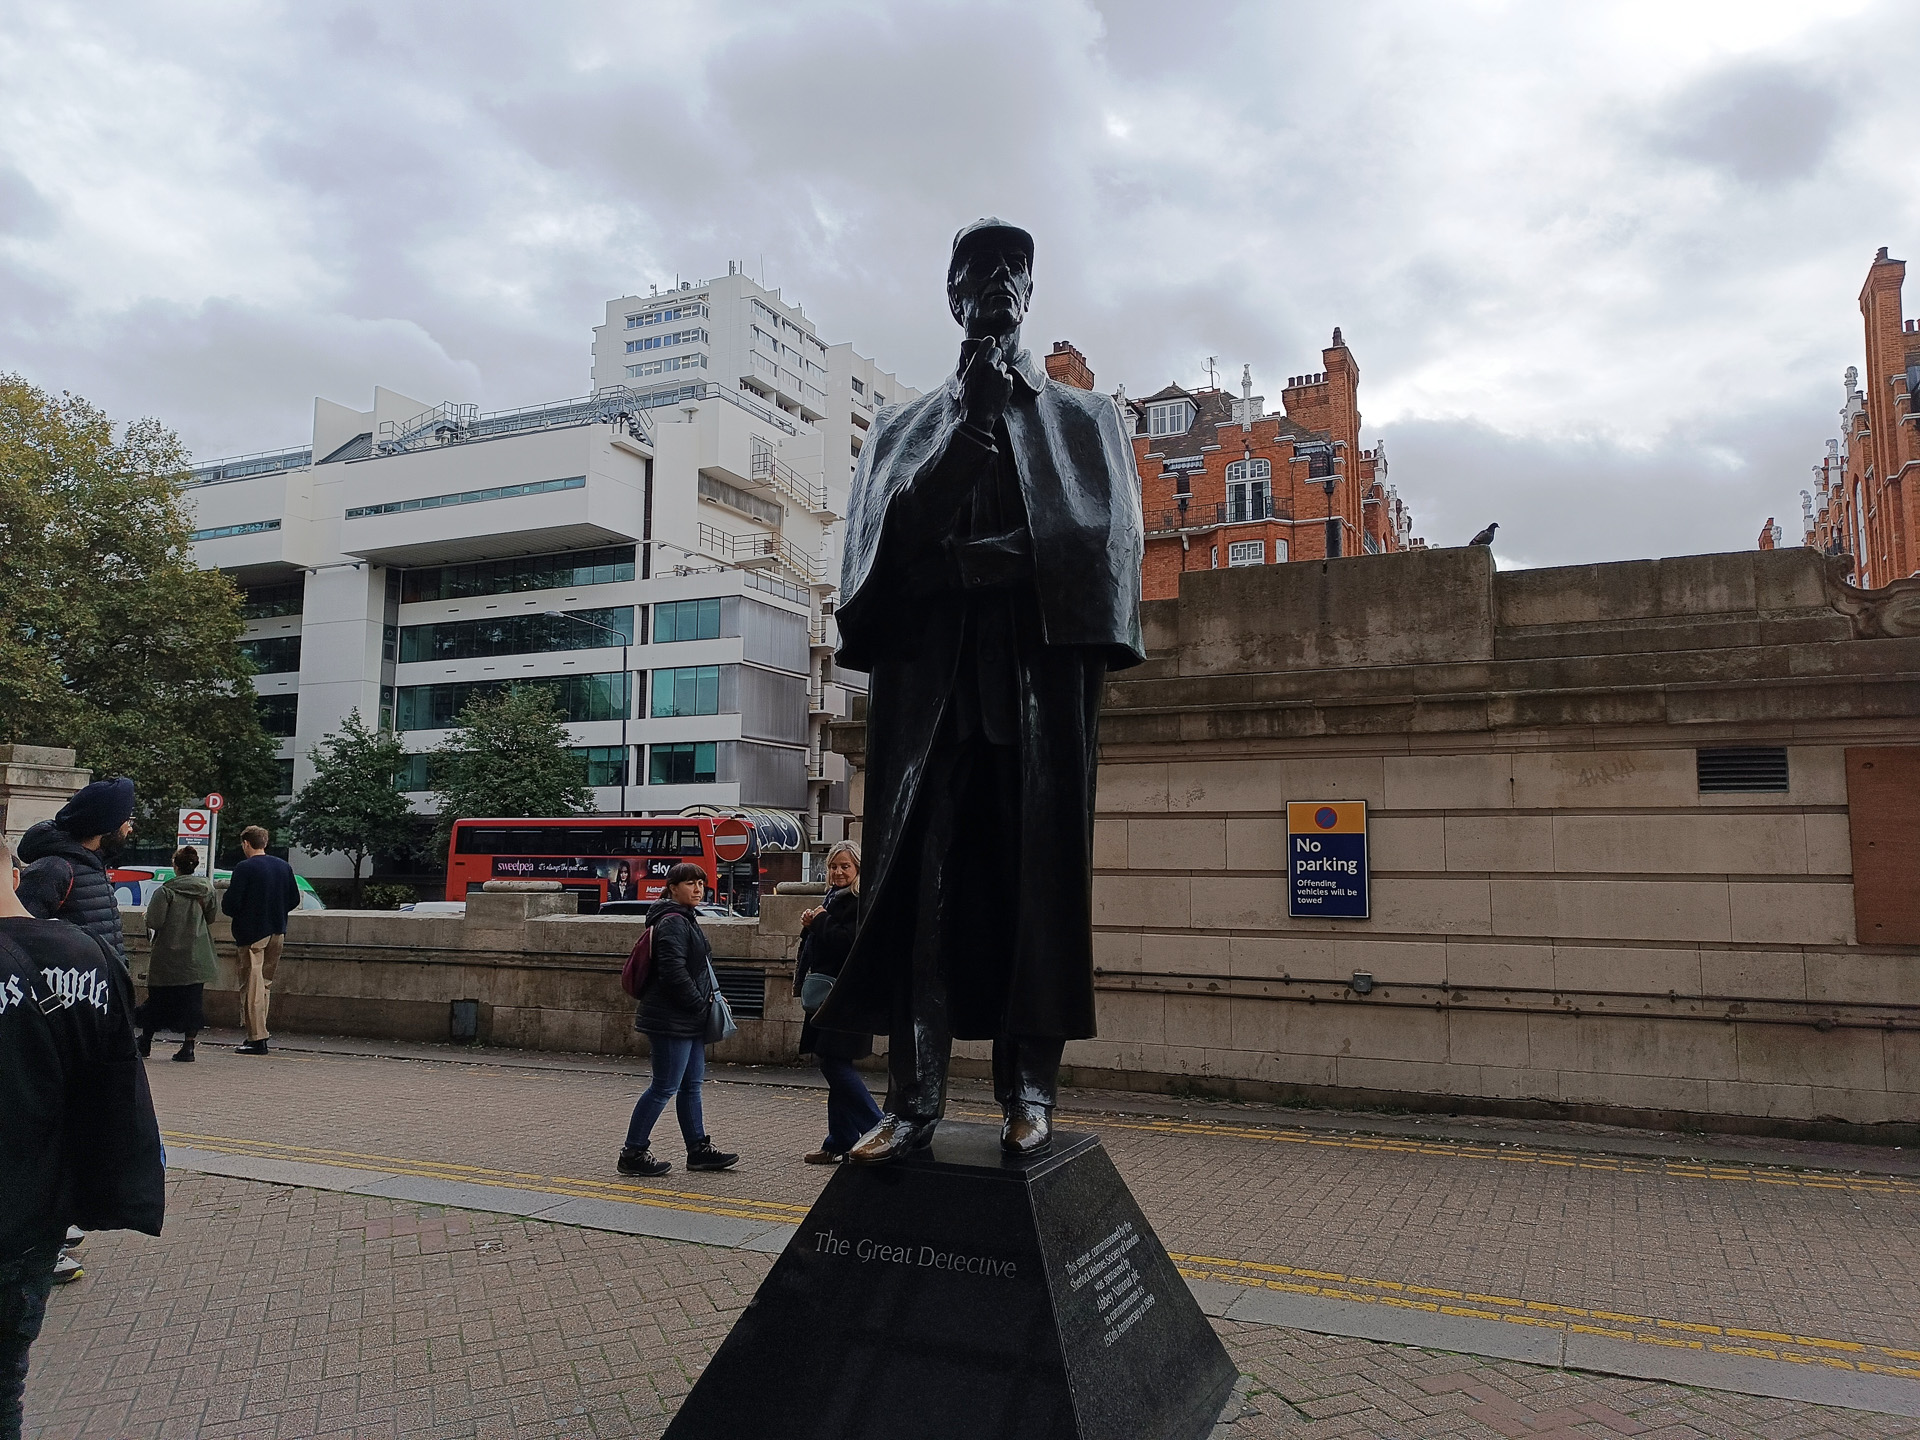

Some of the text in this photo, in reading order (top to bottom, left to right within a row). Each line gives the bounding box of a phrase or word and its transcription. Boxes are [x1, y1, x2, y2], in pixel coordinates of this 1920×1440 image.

[209, 796, 220, 808] D
[1296, 838, 1321, 852] No
[497, 859, 534, 875] sweetpea
[652, 862, 671, 876] sky
[1296, 857, 1358, 875] parking
[1297, 879, 1337, 889] Offending
[1297, 888, 1358, 896] vehicles will be
[30, 966, 109, 1015] ngele
[814, 1229, 1017, 1279] The Great Detective
[1065, 1261, 1078, 1275] This
[1091, 1226, 1121, 1257] commissioned
[1117, 1224, 1127, 1237] by
[1070, 1269, 1092, 1292] Sherlock
[1088, 1259, 1107, 1278] Holmes
[1105, 1247, 1122, 1264] Society
[1123, 1233, 1140, 1250] London
[1094, 1257, 1131, 1291] was sponsored by
[1096, 1268, 1140, 1312] Abbey National plc
[1103, 1326, 1119, 1348] 150th
[1117, 1308, 1143, 1336] Anniversary
[1144, 1293, 1156, 1310] 1999
[1104, 1316, 1111, 1326] to
[1109, 1290, 1140, 1322] commemorate
